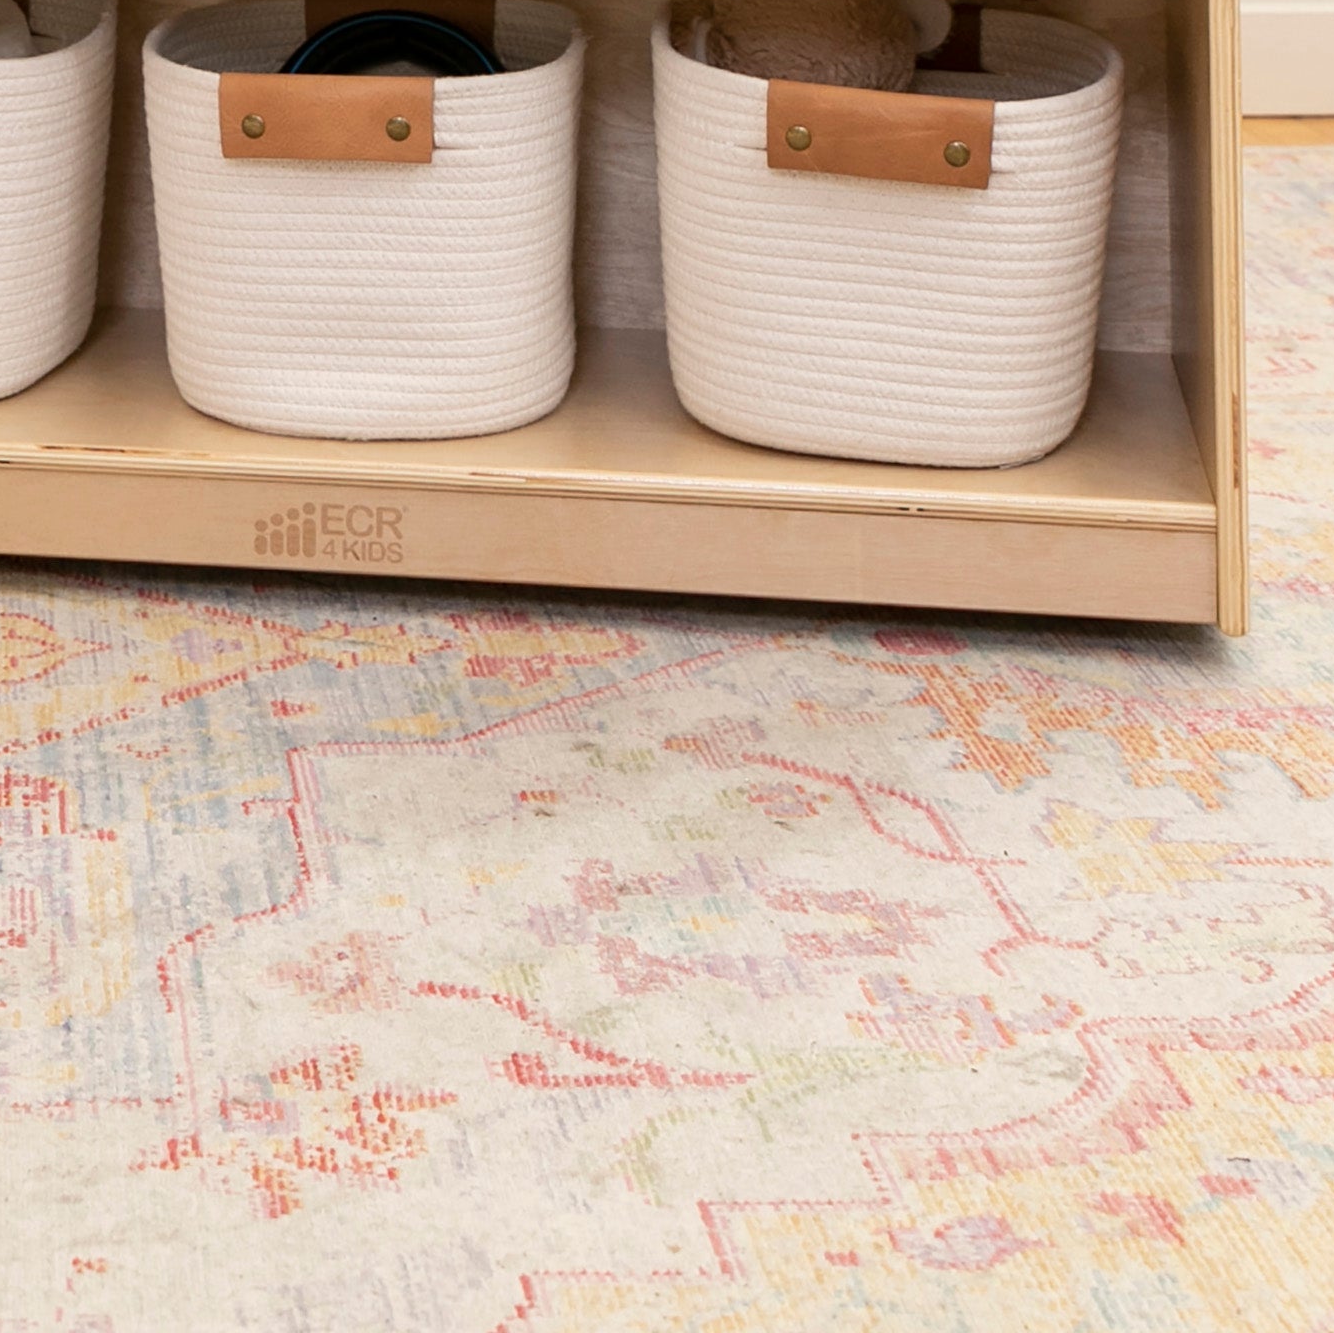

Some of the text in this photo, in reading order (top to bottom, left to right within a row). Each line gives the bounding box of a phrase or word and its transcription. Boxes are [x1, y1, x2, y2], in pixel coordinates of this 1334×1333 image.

[320, 503, 403, 540] ECR
[322, 539, 404, 564] 4 KIDS
